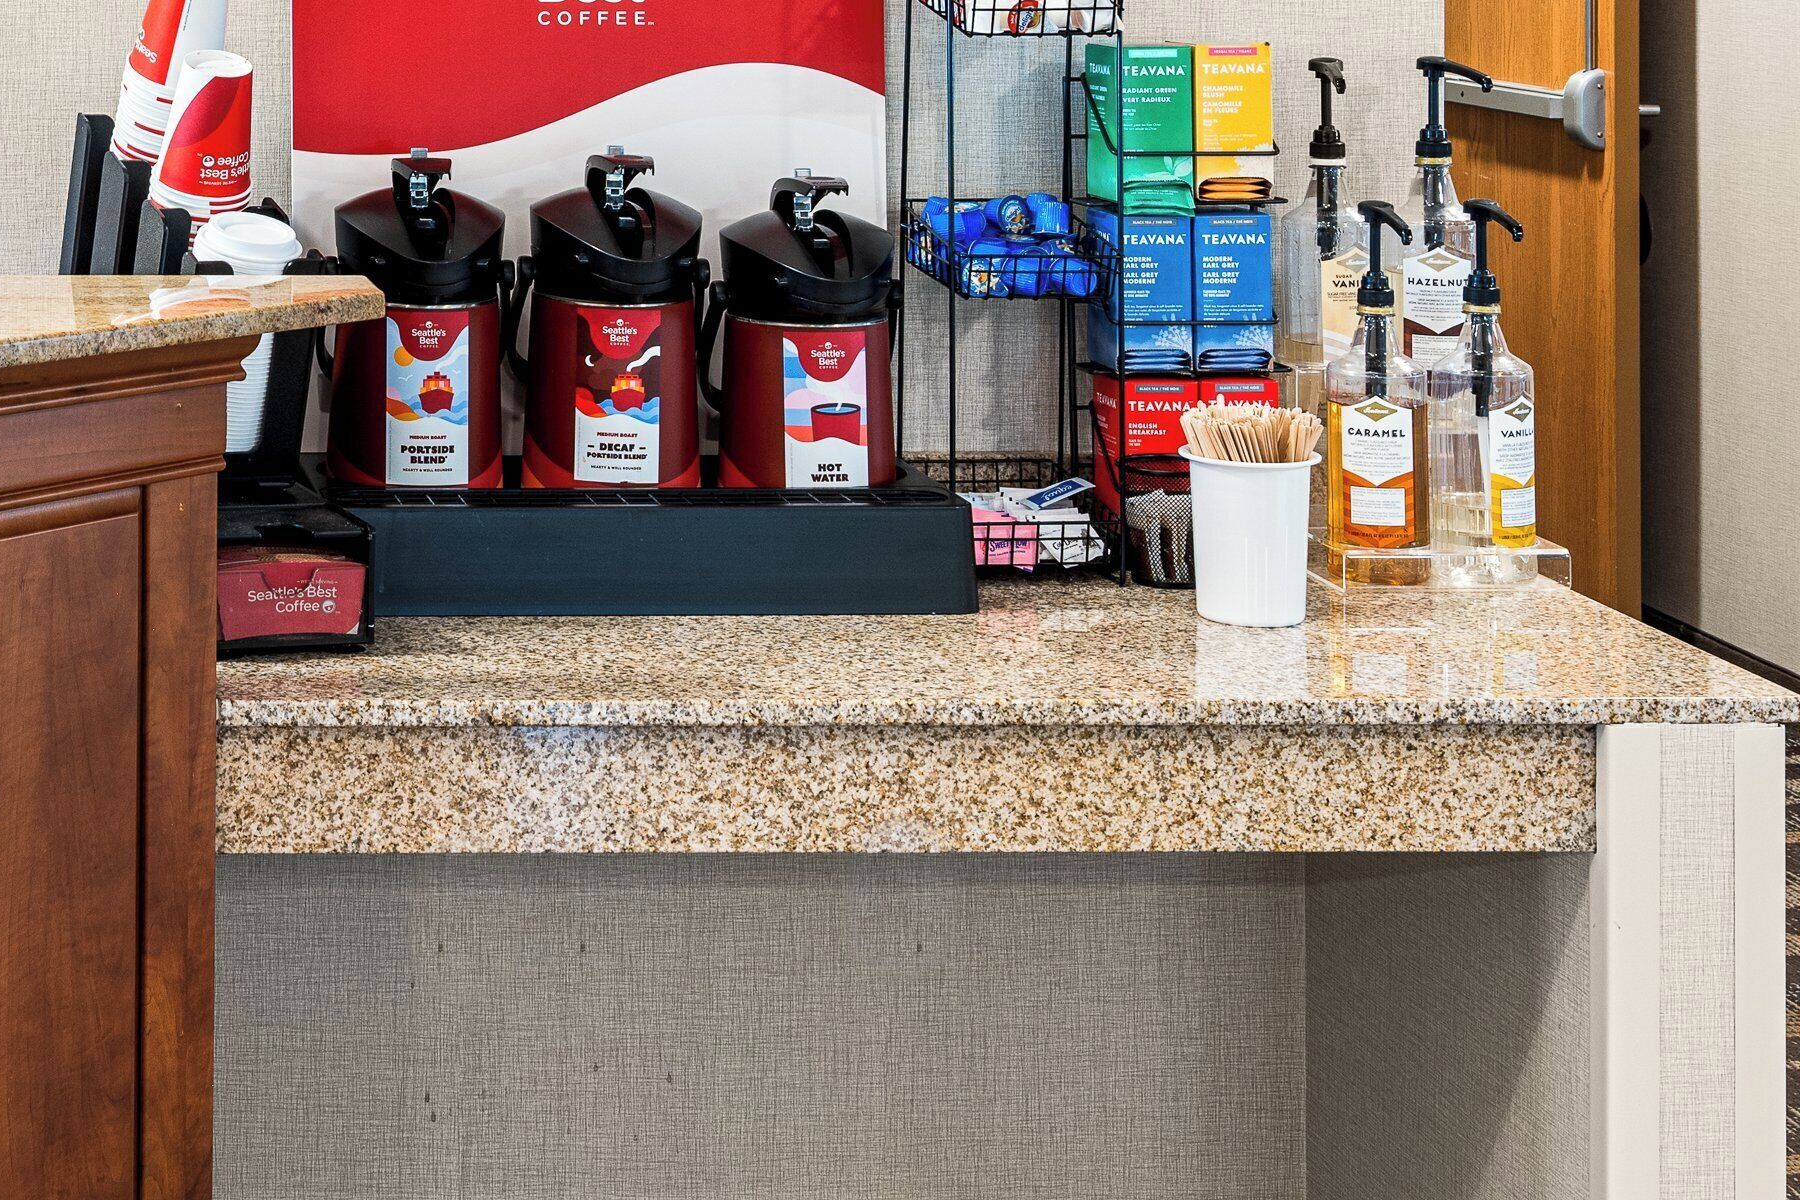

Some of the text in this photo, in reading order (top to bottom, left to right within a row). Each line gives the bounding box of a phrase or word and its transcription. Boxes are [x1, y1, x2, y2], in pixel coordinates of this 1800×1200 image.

[537, 10, 646, 26] COFFEE
[1122, 65, 1186, 76] TEAVANA
[1202, 64, 1265, 74] TEAVANA
[217, 152, 248, 167] Coffee
[200, 169, 228, 180] Best
[1123, 234, 1184, 244] TEAVANA
[1202, 234, 1265, 244] TEAVANA
[1408, 277, 1468, 286] HAZELNUT
[411, 329, 446, 337] Seattle's
[602, 326, 638, 335] Seattle's
[610, 334, 630, 342] Best
[810, 349, 846, 358] Seattle's
[1128, 401, 1190, 411] TEAVANA
[1348, 428, 1405, 437] CARAMEL
[401, 445, 454, 453] PORTSIDE
[600, 443, 635, 451] DECAF
[811, 474, 849, 482] WATER
[248, 583, 337, 602] Seattle's Best
[275, 600, 319, 612] Coffee
